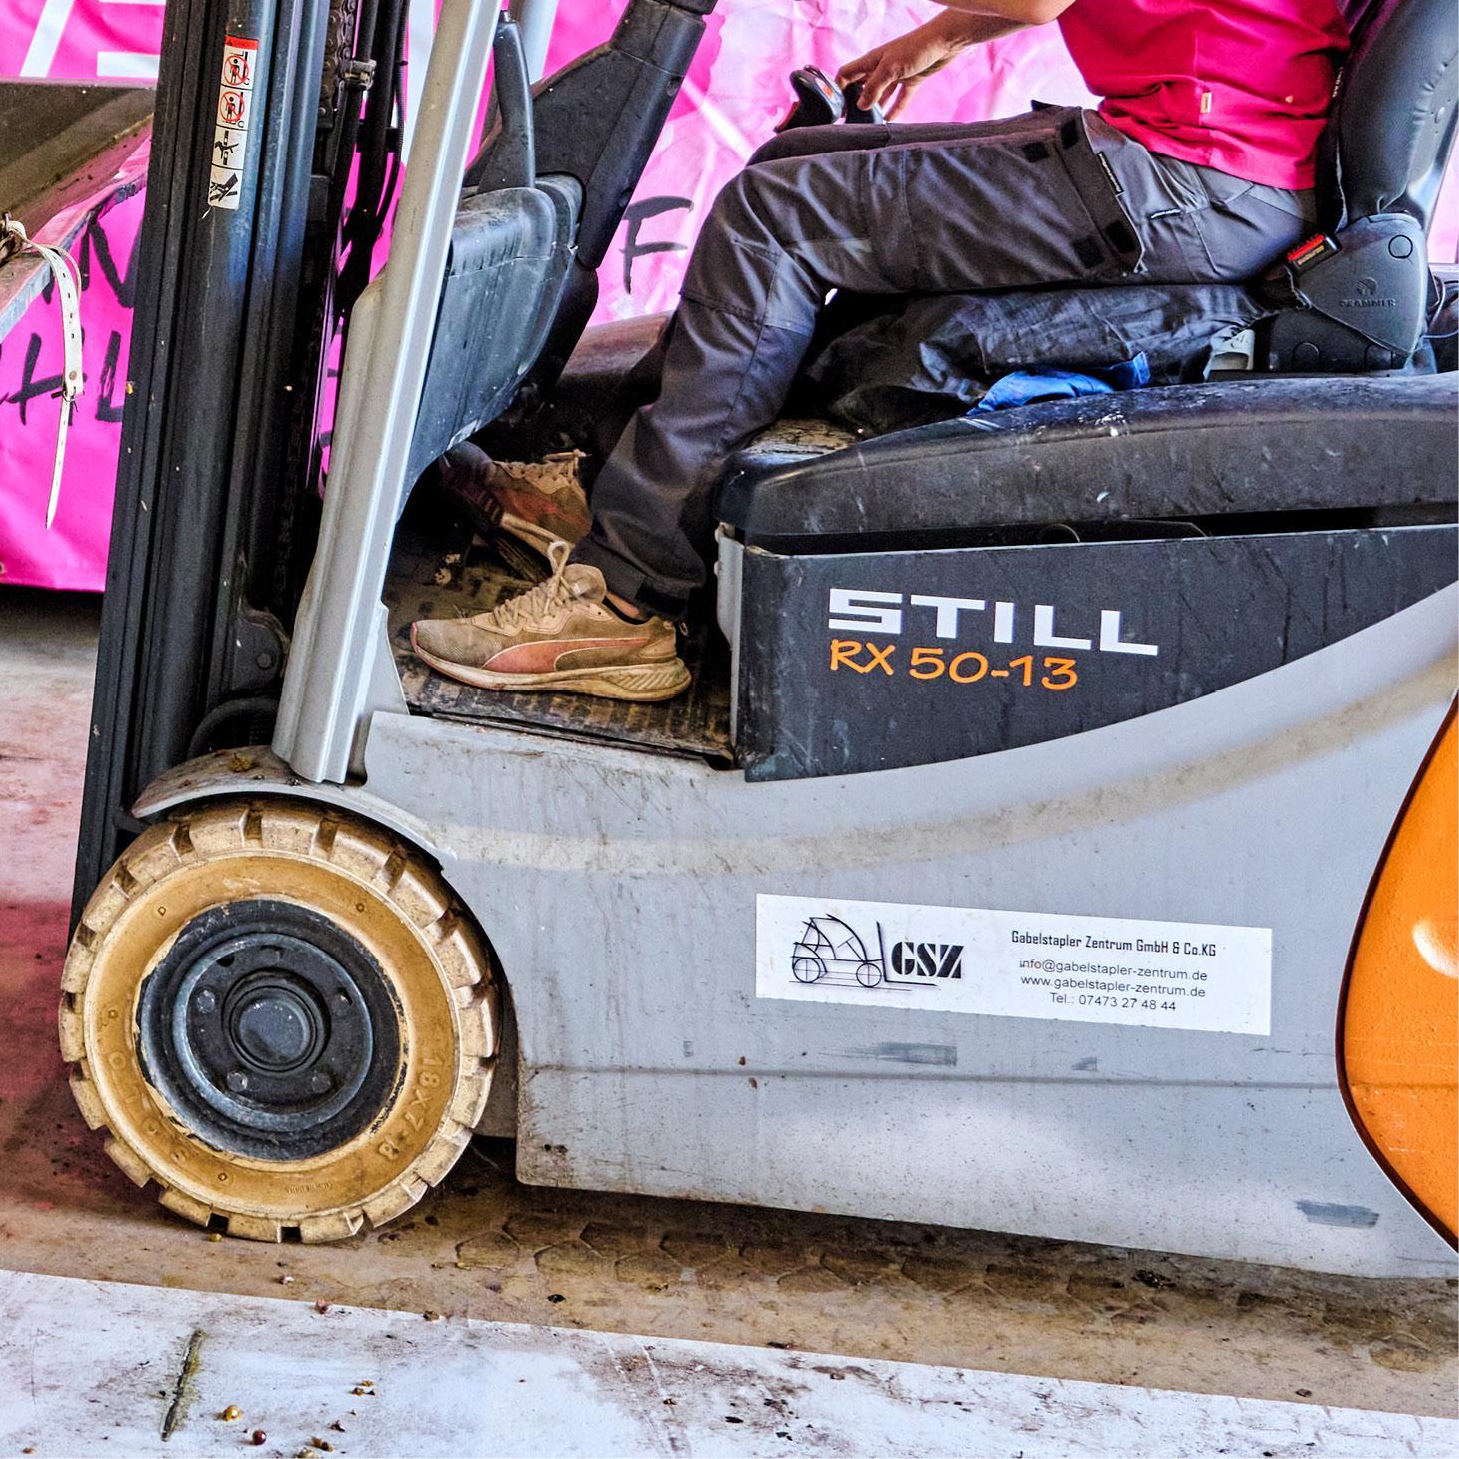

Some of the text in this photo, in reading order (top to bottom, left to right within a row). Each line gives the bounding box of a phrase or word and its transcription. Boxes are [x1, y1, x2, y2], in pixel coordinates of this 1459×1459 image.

[829, 588, 1159, 656] STILL
[830, 639, 1079, 690] RX 50-13
[1011, 930, 1082, 948] Gabelstapler
[1086, 935, 1132, 951] Zentrum
[1136, 939, 1169, 954] GmbH
[1172, 942, 1180, 955] &
[892, 941, 964, 979] GSZ
[1019, 958, 1208, 981] info@gabelstapler-zentrum.de
[1020, 976, 1206, 998] www.gabelstapler-zentrum.de
[1050, 992, 1176, 1012] Tel.: 07473 27 48 44
